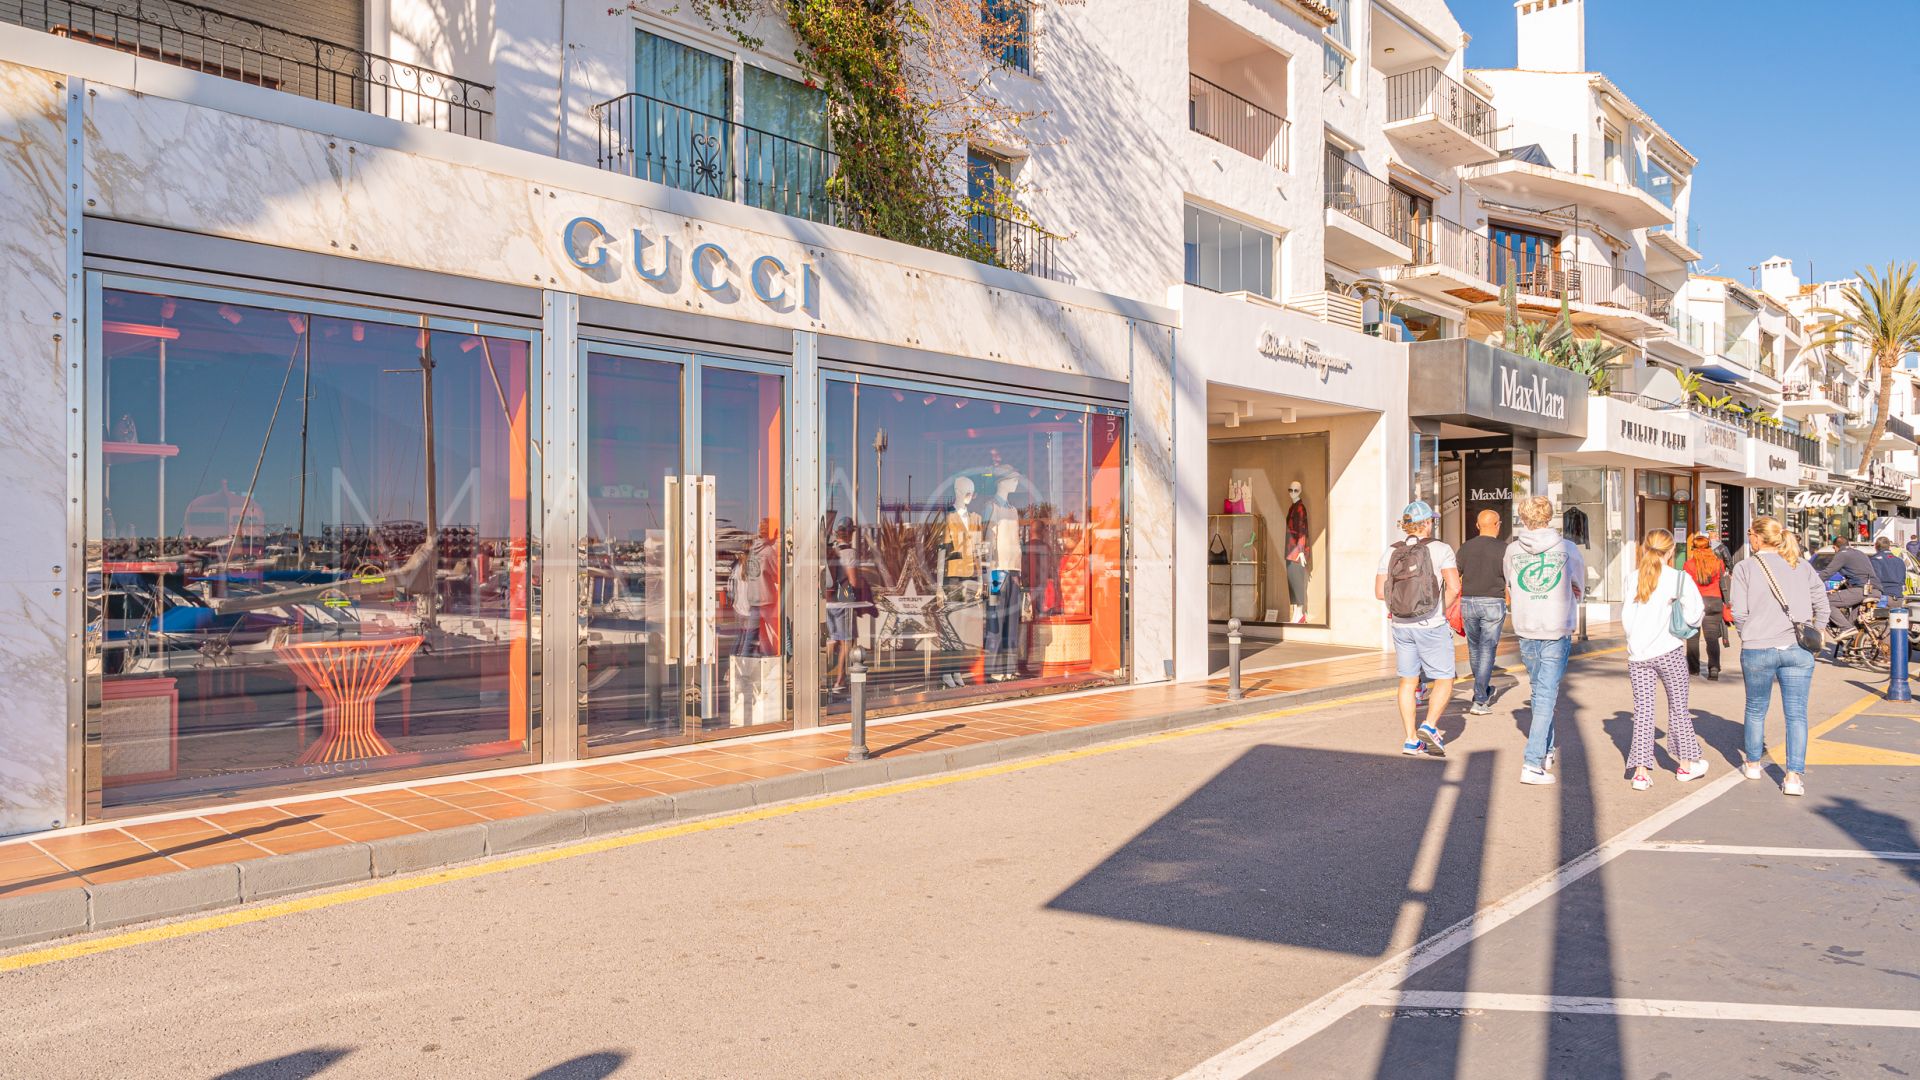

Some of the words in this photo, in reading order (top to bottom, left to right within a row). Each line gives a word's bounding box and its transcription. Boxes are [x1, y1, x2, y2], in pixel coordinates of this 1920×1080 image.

[562, 216, 811, 310] GUCCI
[1499, 365, 1565, 420] MaxMara
[1620, 420, 1659, 444] PHILIPP
[1661, 430, 1686, 450] PLEIN
[1793, 486, 1850, 513] Jacks
[303, 760, 368, 776] GUCCI
